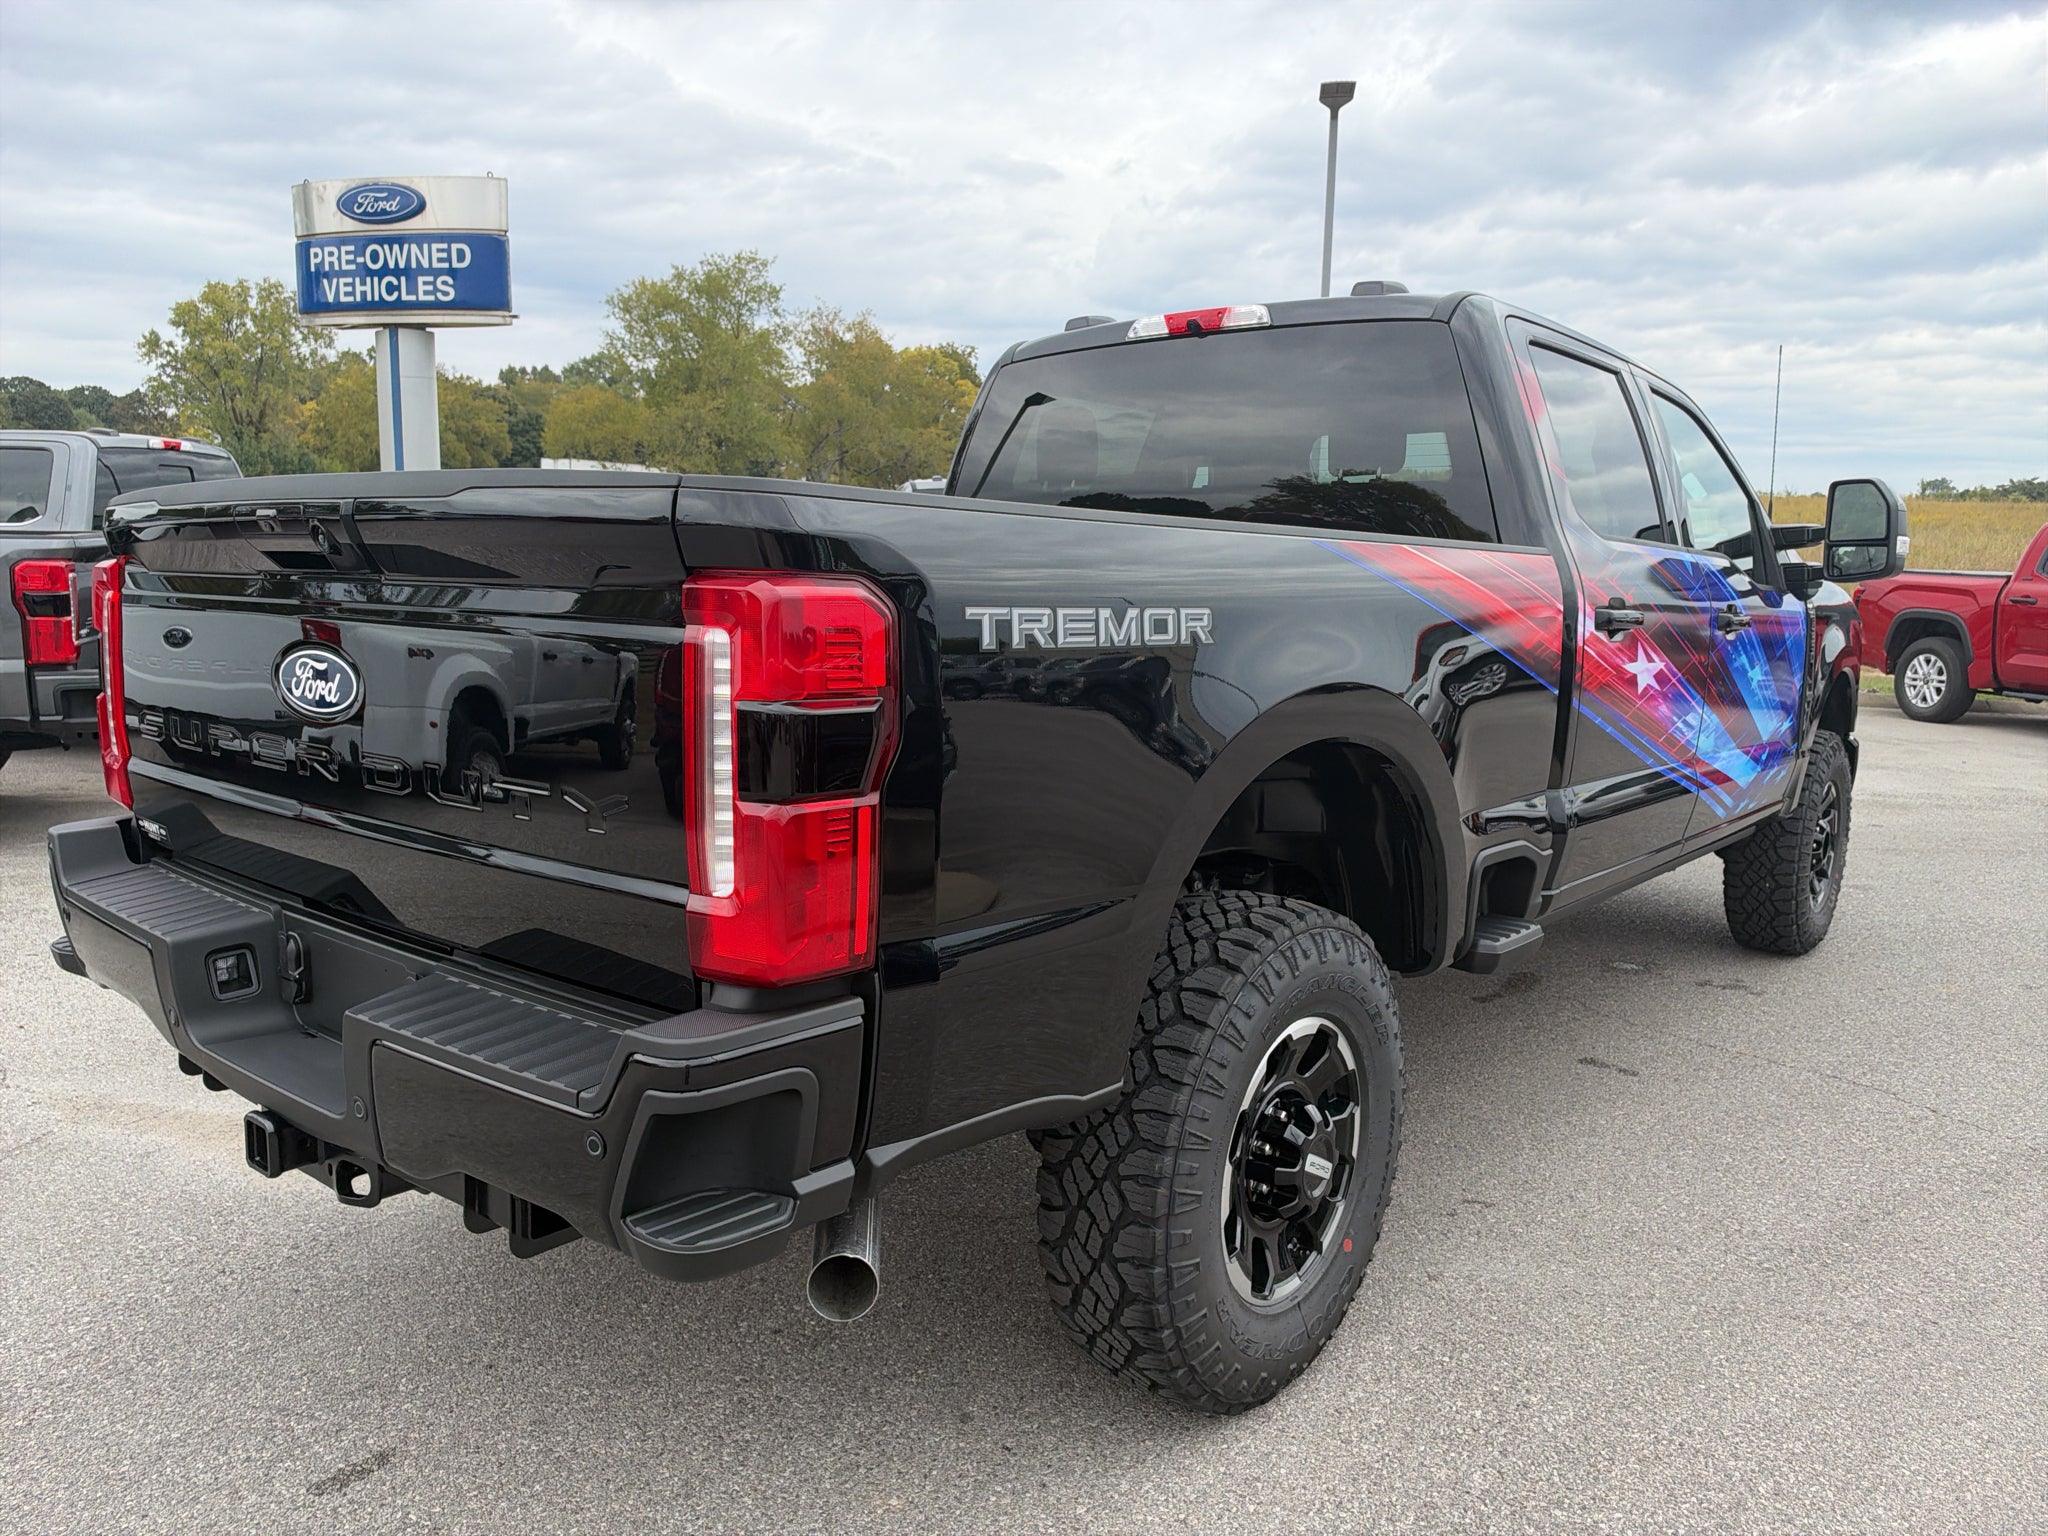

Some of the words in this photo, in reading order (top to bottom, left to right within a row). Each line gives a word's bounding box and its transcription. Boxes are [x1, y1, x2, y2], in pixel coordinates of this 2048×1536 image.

[353, 191, 401, 214] Ford
[309, 242, 472, 273] PRE-OWNED
[322, 275, 456, 303] VEHICLES
[964, 606, 1215, 650] TREMOR
[291, 657, 341, 704] Ford
[138, 709, 340, 783] SUPER
[360, 752, 630, 835] DUTY
[1309, 1161, 1330, 1174] FORD
[1216, 1264, 1355, 1361] GOODYEAR
